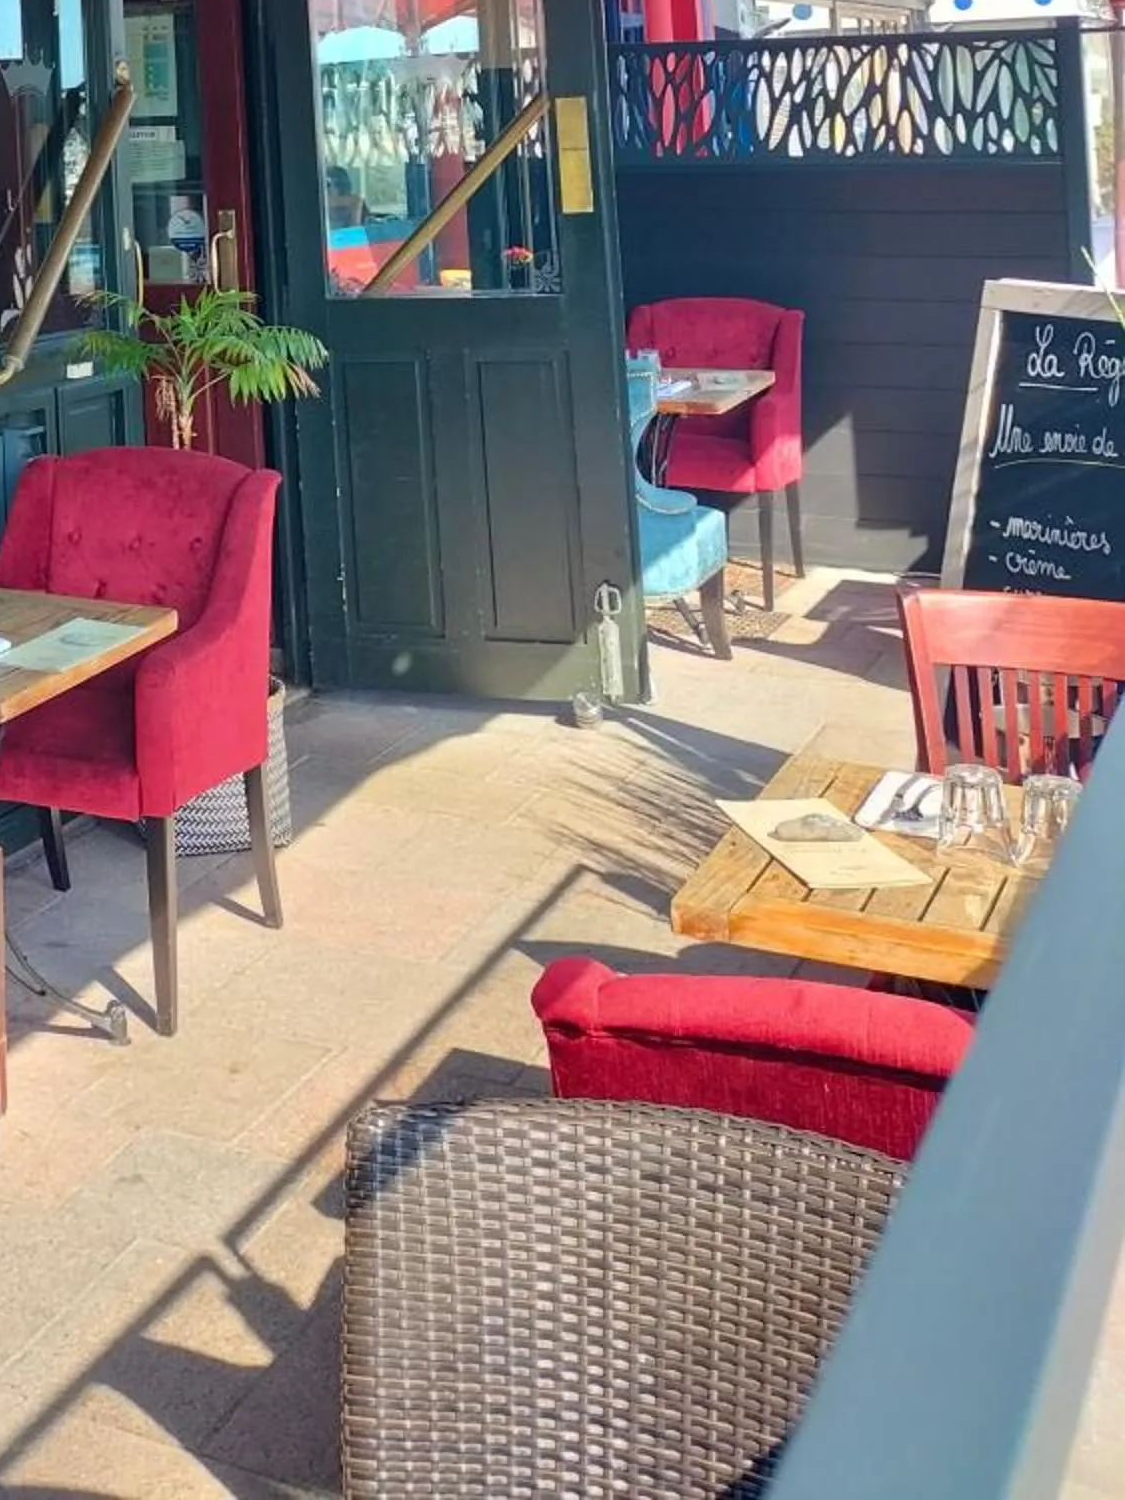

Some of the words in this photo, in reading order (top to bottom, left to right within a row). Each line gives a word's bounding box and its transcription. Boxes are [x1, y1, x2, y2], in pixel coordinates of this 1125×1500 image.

[1026, 323, 1065, 378] La
[989, 403, 1034, 458] Une
[1091, 426, 1119, 458] de
